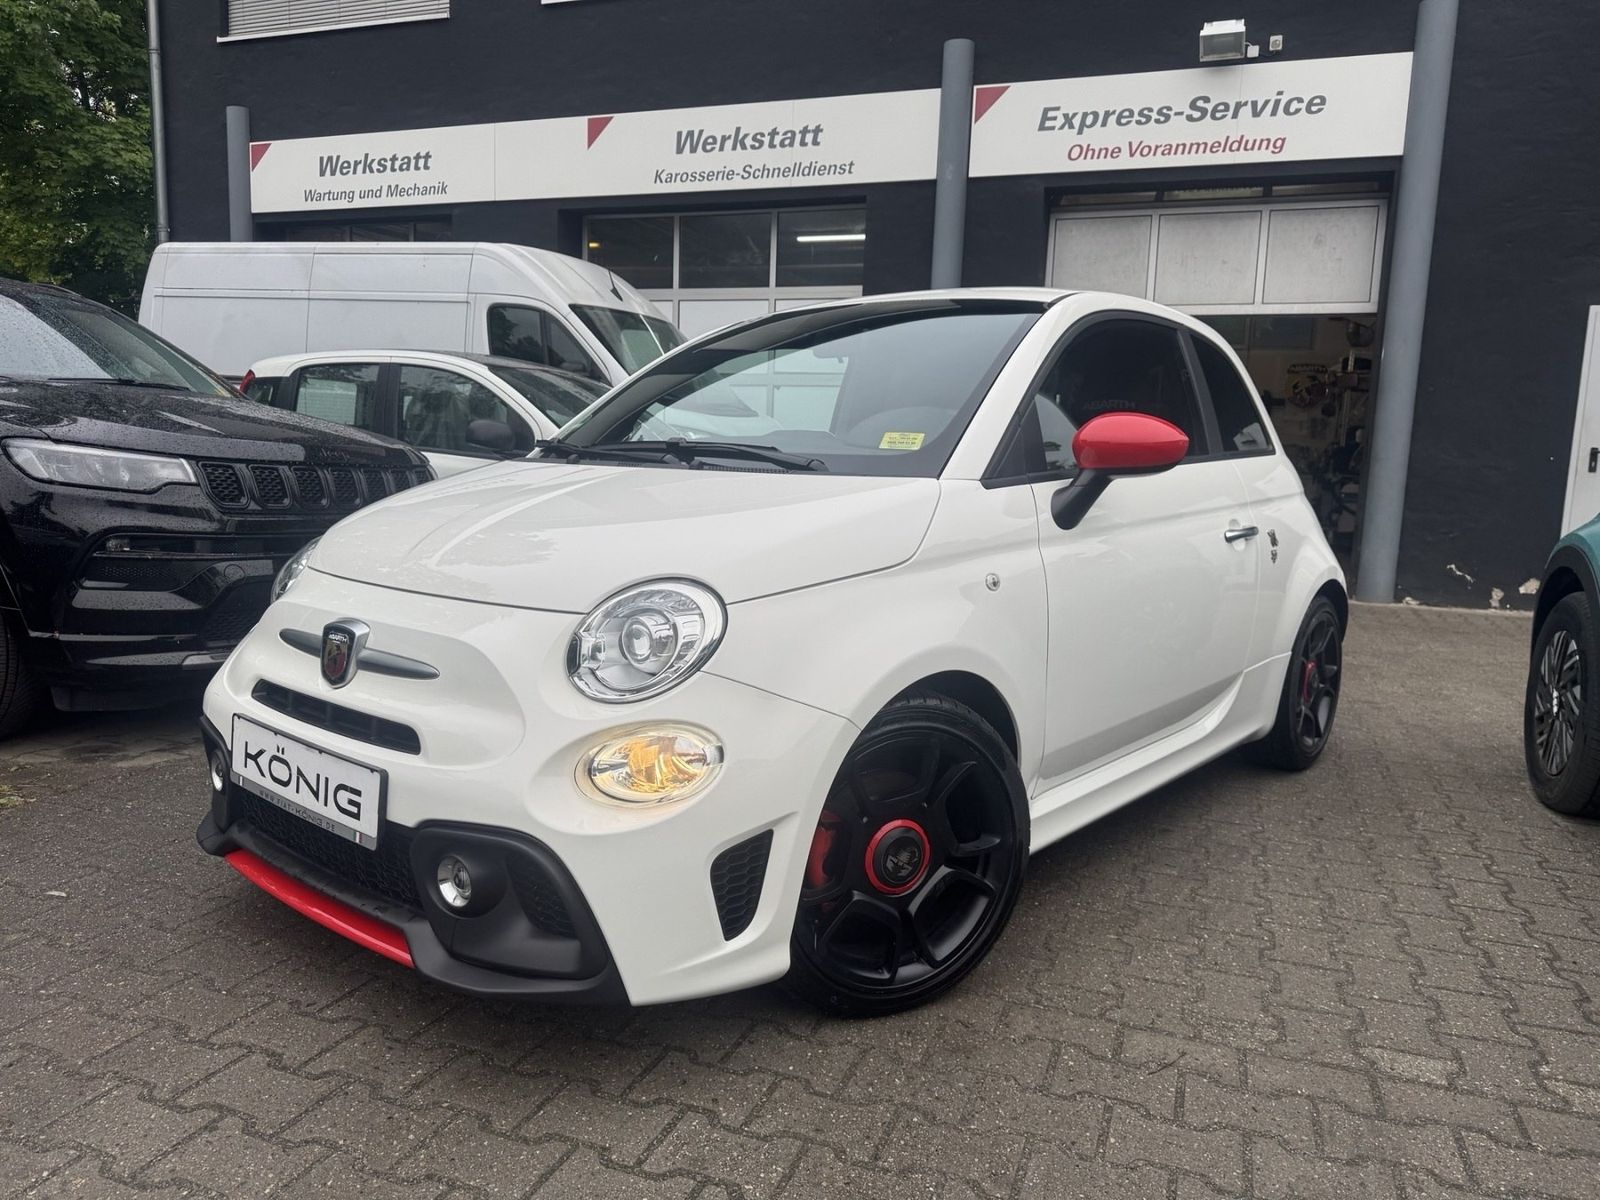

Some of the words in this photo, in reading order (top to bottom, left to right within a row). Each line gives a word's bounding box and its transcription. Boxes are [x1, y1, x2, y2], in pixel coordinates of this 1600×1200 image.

[1037, 90, 1327, 136] Express-Service
[675, 123, 824, 155] Werkstatt
[1066, 143, 1122, 162] Ohne
[1127, 134, 1287, 158] Voranmeldung
[318, 150, 433, 178] Werkstatt
[653, 160, 856, 185] Karosserie-Schnelldienst
[303, 188, 356, 204] Wartung
[358, 185, 383, 200] und
[385, 181, 448, 199] Mechanik
[244, 740, 362, 821] KÖNIG
